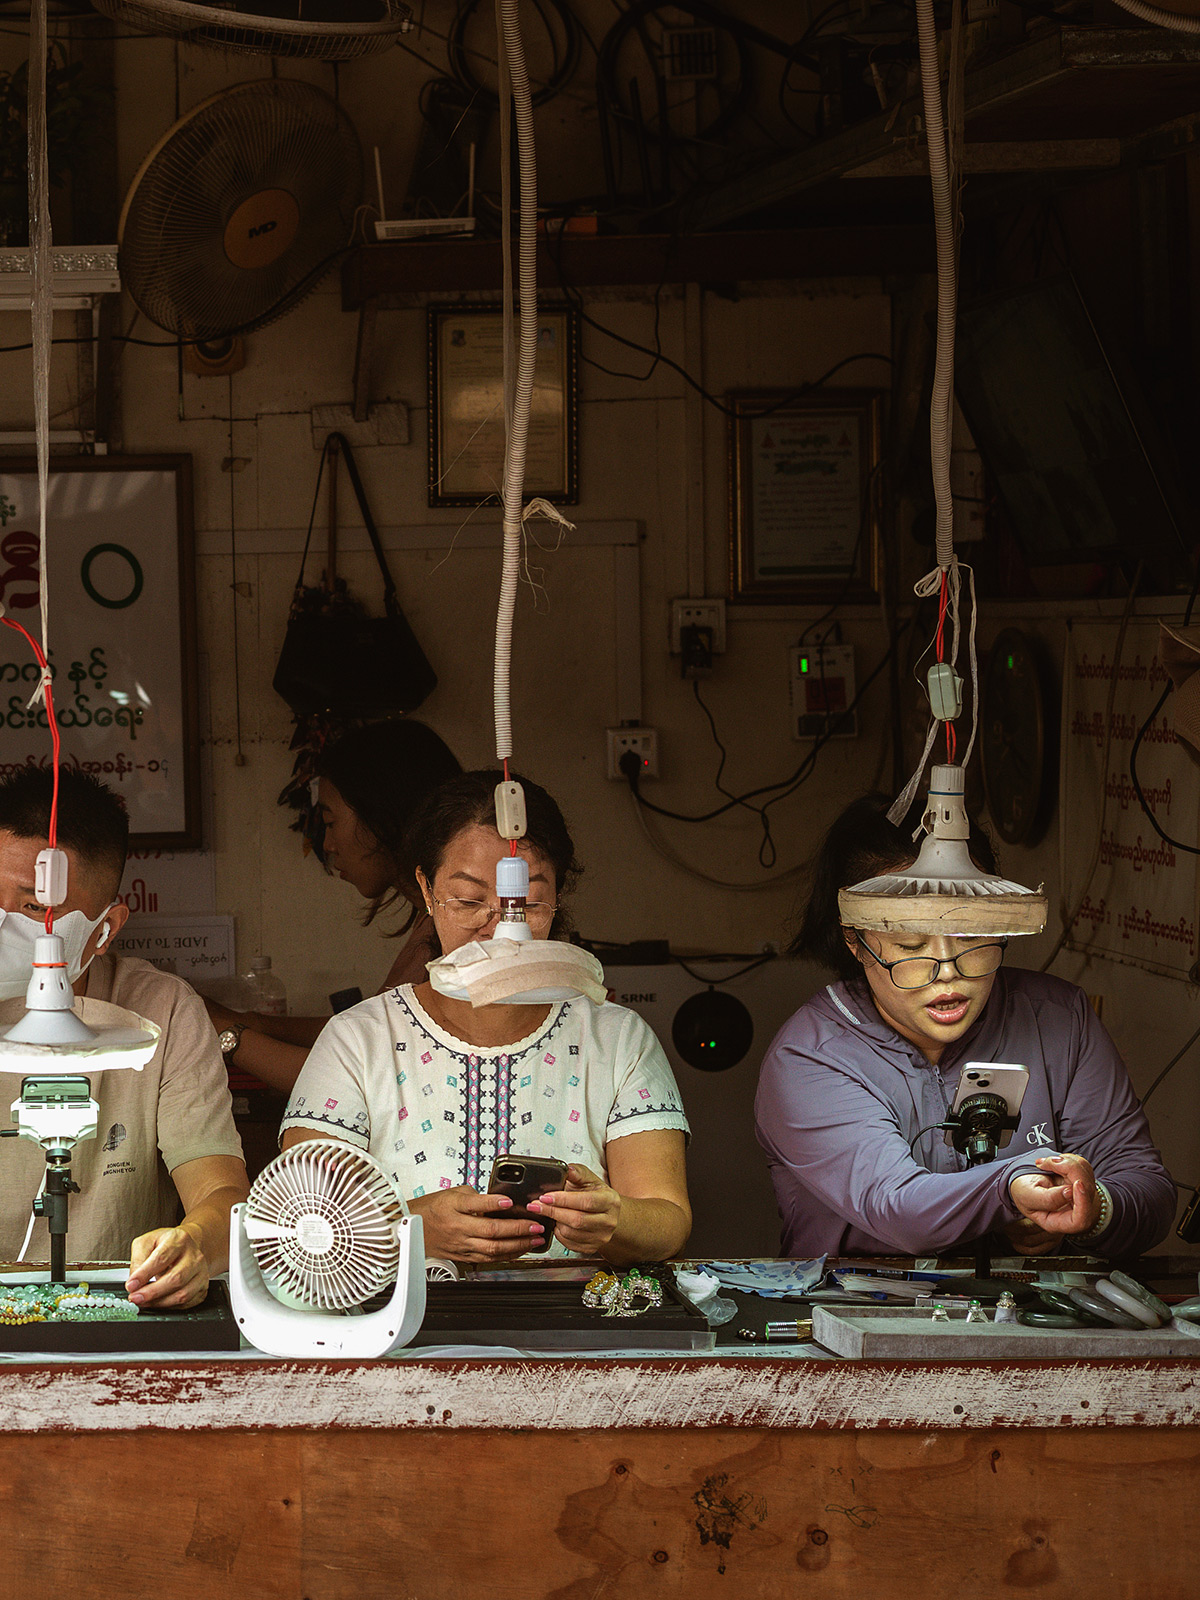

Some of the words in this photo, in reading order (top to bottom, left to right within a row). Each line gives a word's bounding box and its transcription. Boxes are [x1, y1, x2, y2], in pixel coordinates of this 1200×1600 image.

[117, 938, 152, 950] JADE
[174, 936, 208, 949] JADE
[621, 993, 657, 1003] SRNE
